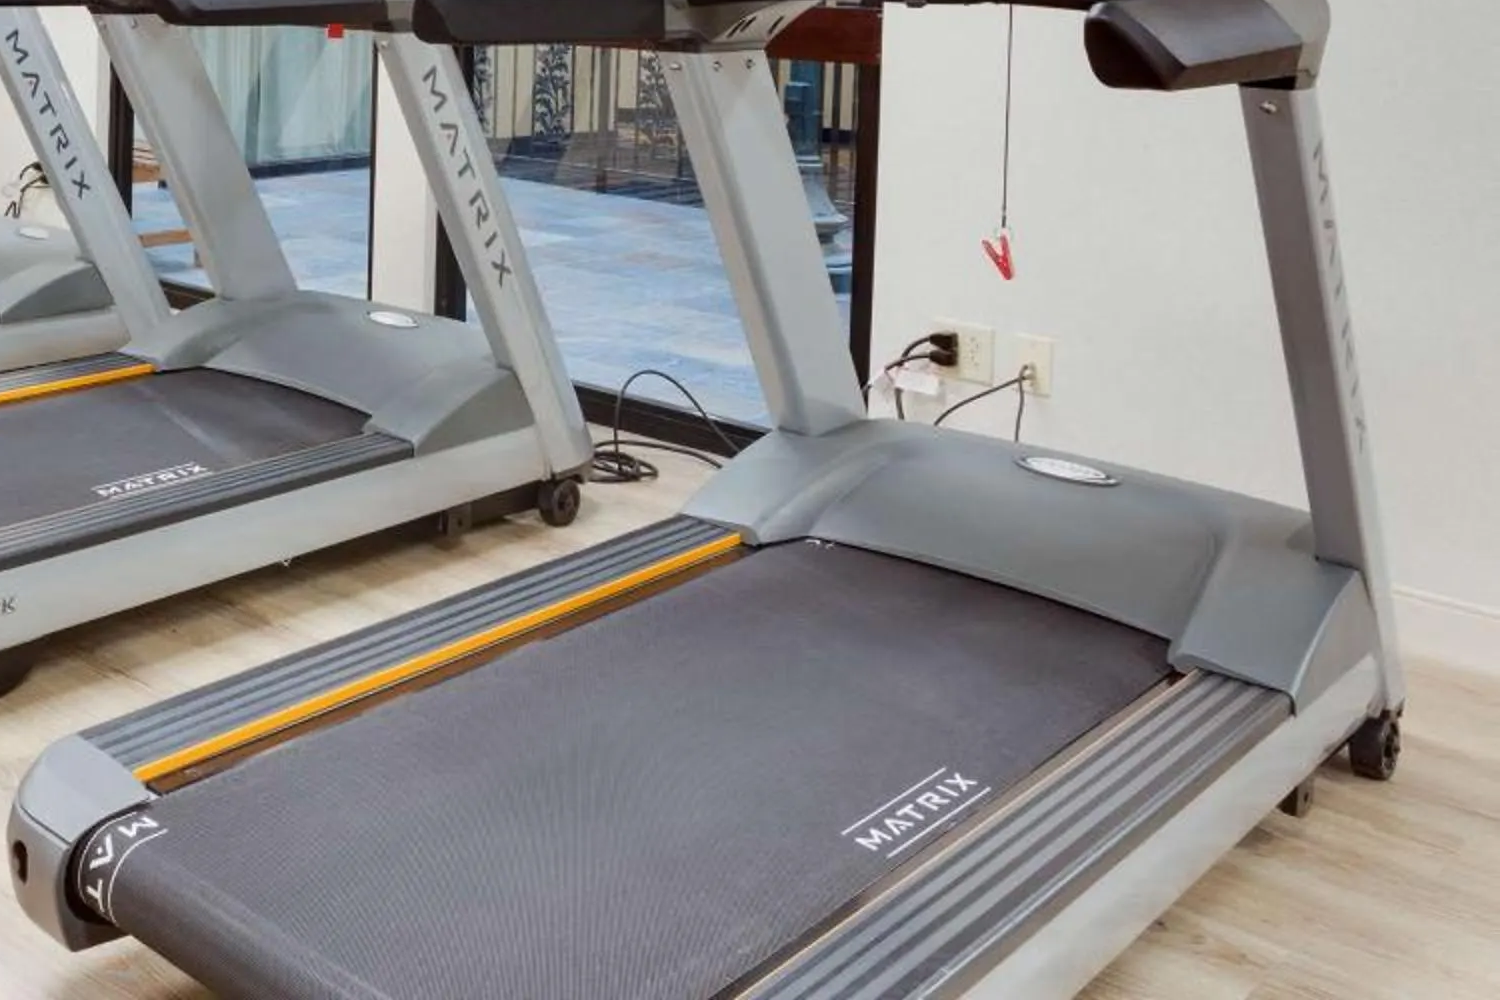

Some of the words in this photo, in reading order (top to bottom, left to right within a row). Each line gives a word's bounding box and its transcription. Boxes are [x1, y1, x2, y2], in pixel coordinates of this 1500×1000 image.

[4, 28, 92, 201] MATRIX
[422, 64, 513, 289] MATRIX
[95, 464, 208, 497] MATRIX
[855, 773, 978, 851] MATRIX
[85, 816, 159, 913] MAT
